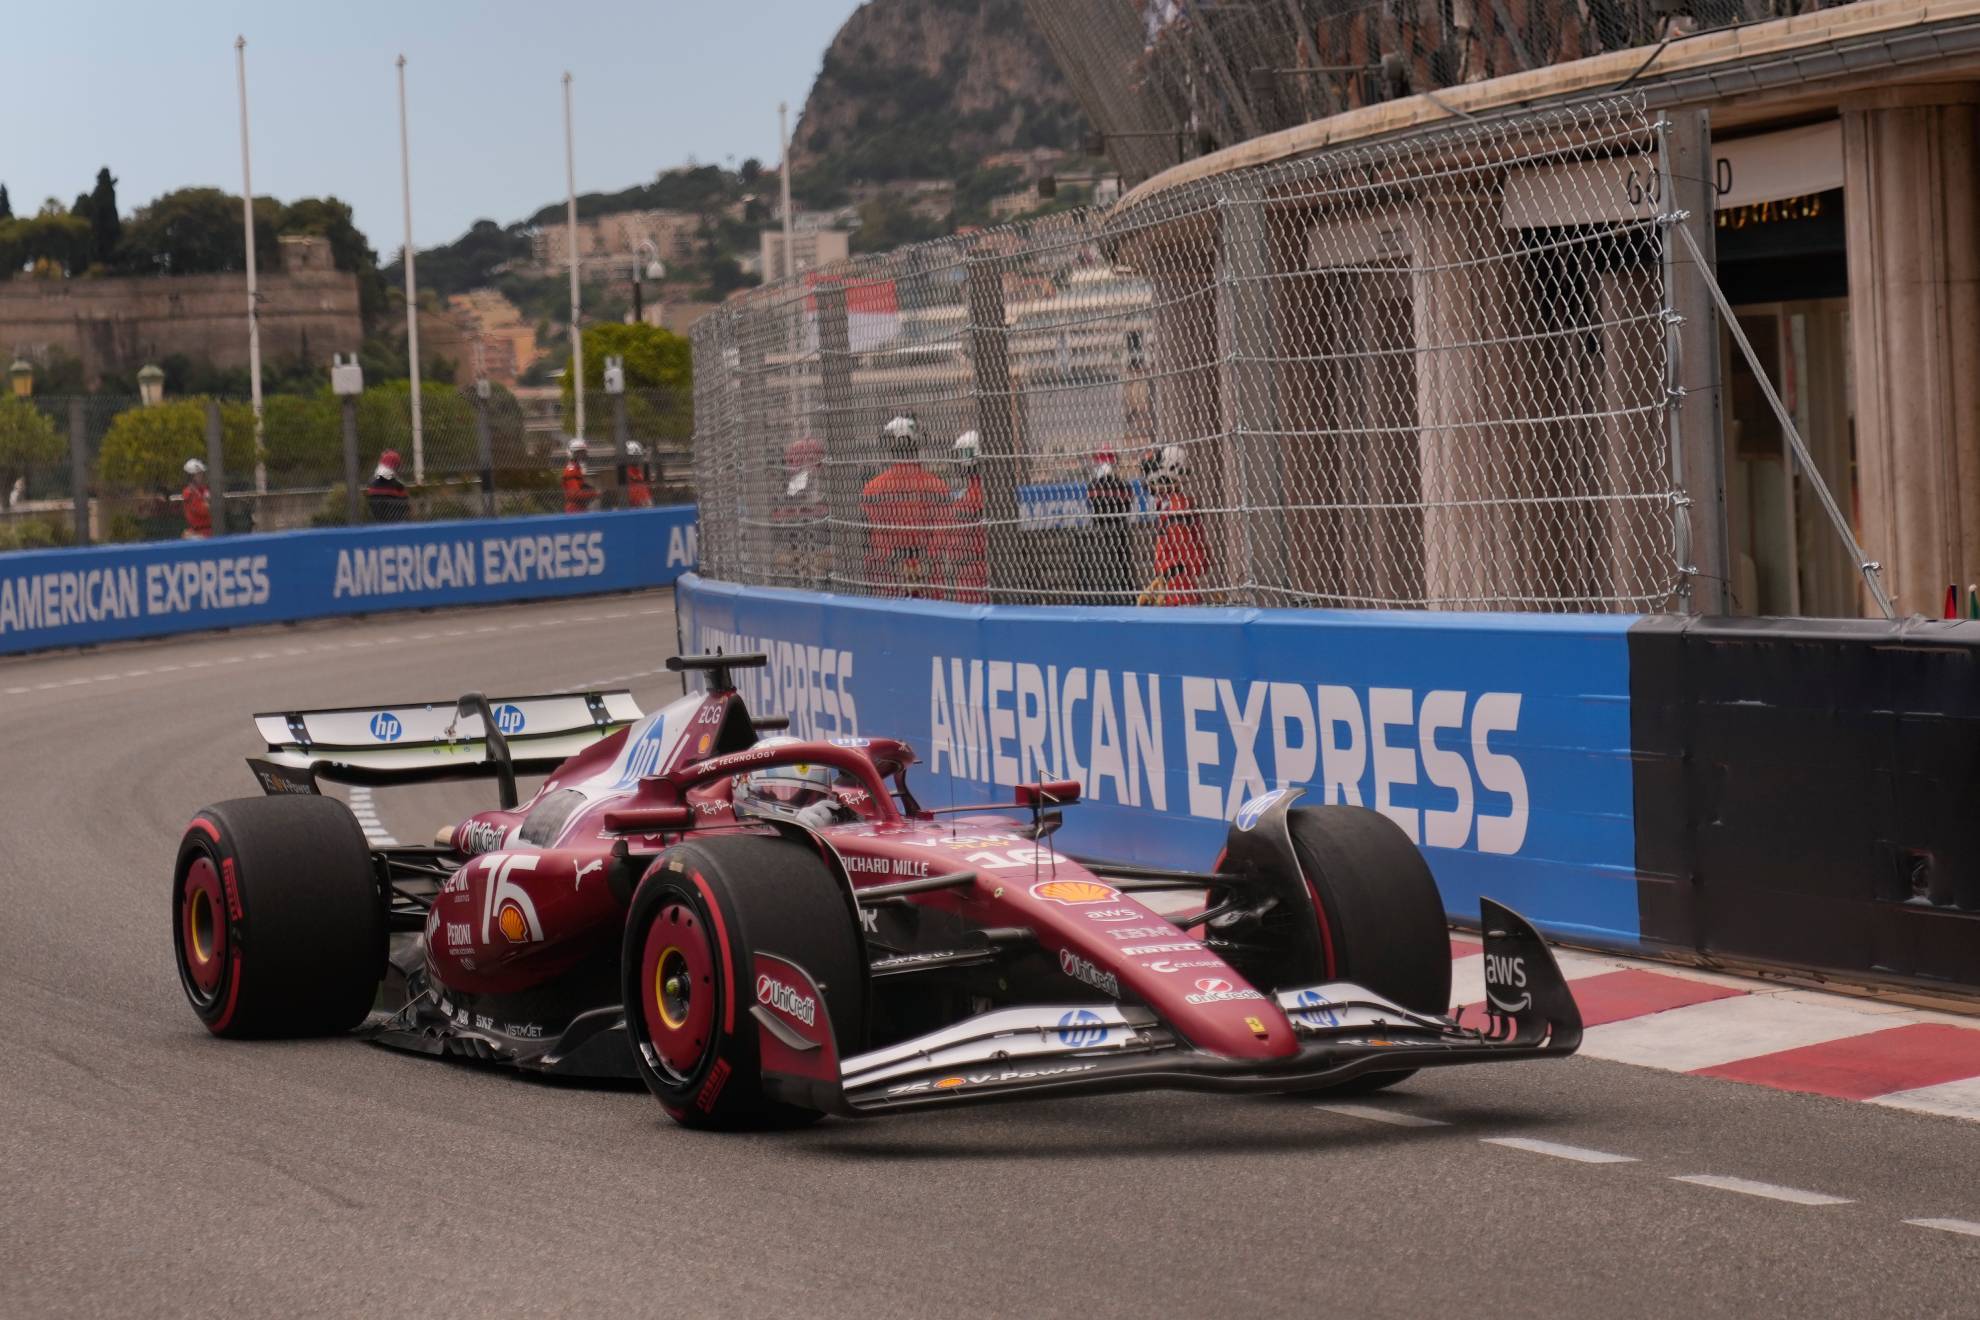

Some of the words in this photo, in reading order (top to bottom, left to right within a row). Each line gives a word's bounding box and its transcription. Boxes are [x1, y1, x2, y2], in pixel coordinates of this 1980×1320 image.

[333, 540, 476, 598] AMERICAN
[482, 531, 605, 585] EXPRESS
[0, 565, 139, 634] AMERICAN
[146, 554, 270, 615] EXPRESS
[760, 638, 858, 741] EXPRESS
[374, 712, 399, 742] hp
[499, 704, 522, 734] hp
[720, 751, 776, 766] TECHNOLOGY
[931, 656, 1167, 811] AMERICAN
[1182, 676, 1529, 855] EXPRESS
[840, 856, 889, 874] RICHARD
[892, 859, 929, 877] MILLE
[965, 849, 1068, 869] 16
[447, 922, 472, 946] PERONI
[1105, 926, 1178, 940] IBM
[1071, 954, 1121, 1000] UniCredit
[1485, 953, 1528, 989] aws
[771, 980, 815, 1027] UniCredit
[1184, 989, 1266, 1005] UniCredit
[1064, 1008, 1103, 1048] hp
[967, 1063, 1097, 1084] V-Power
